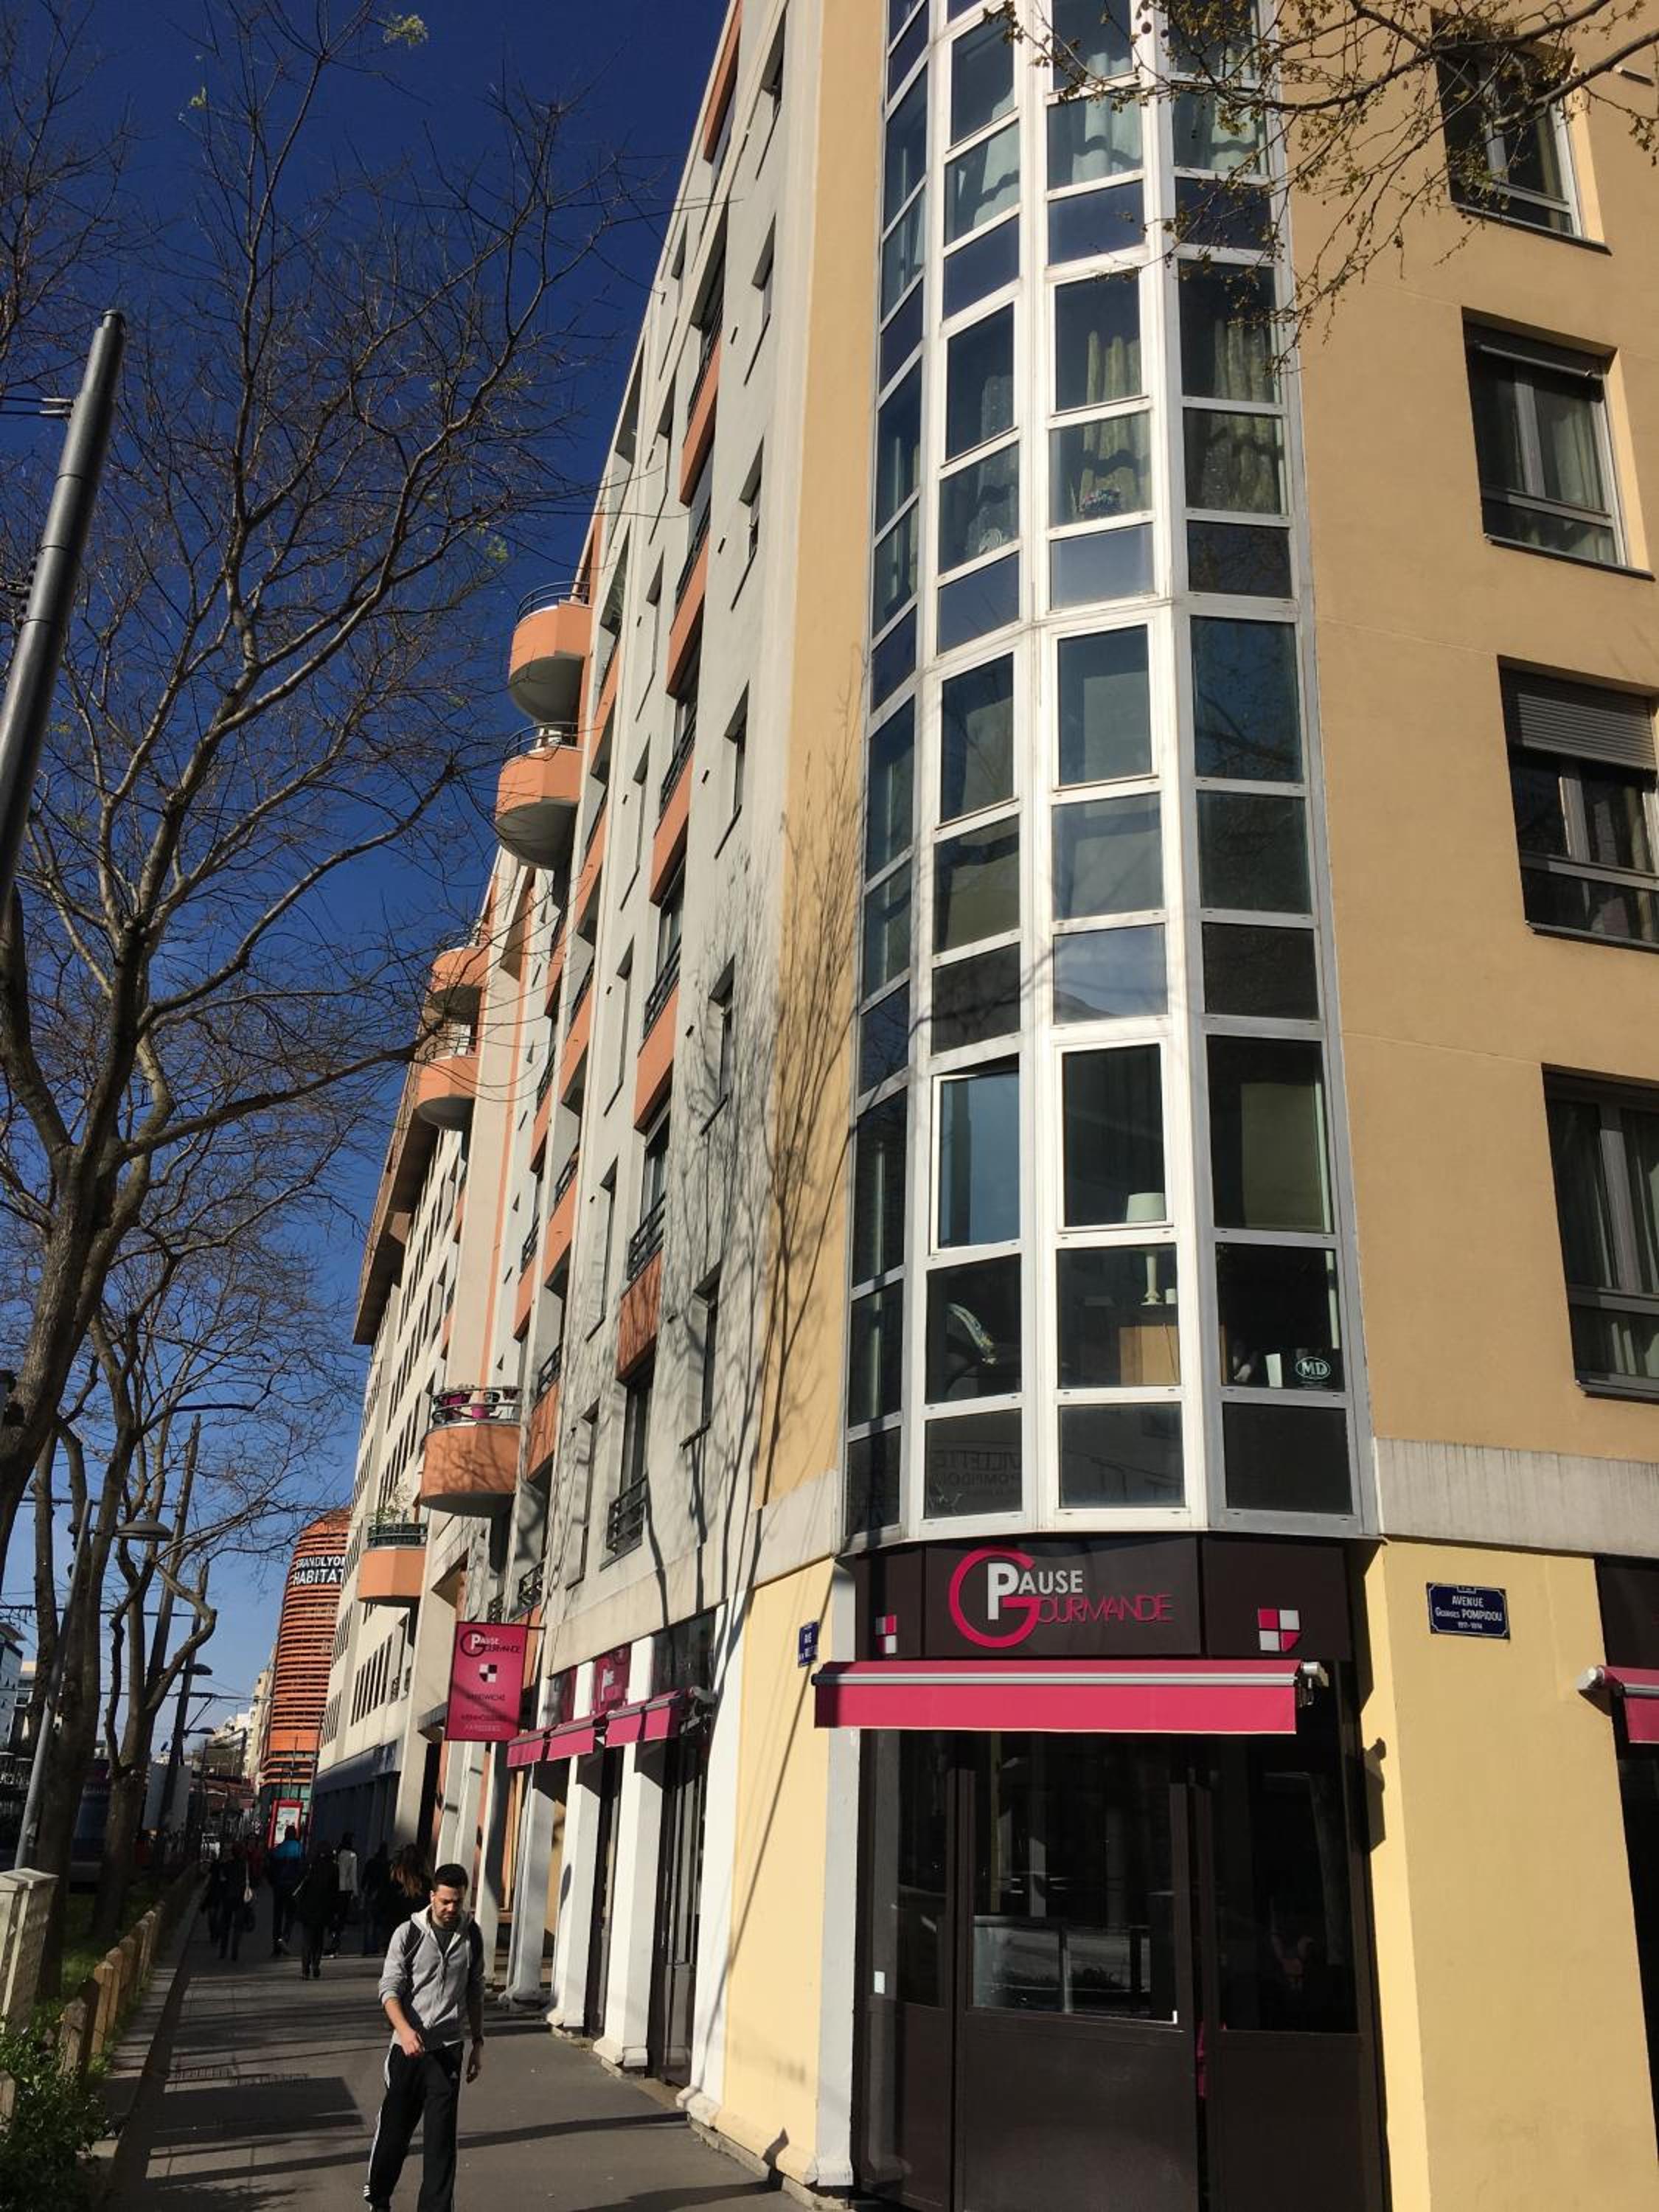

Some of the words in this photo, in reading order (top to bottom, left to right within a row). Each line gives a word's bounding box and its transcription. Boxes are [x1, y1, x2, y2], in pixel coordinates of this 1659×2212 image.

[1301, 1361, 1328, 1375] MD
[293, 1568, 344, 1585] HABITAT
[987, 1562, 1084, 1620] PAUSE
[1452, 1595, 1484, 1607] AVENUE
[1461, 1608, 1502, 1621] POMPIDOU
